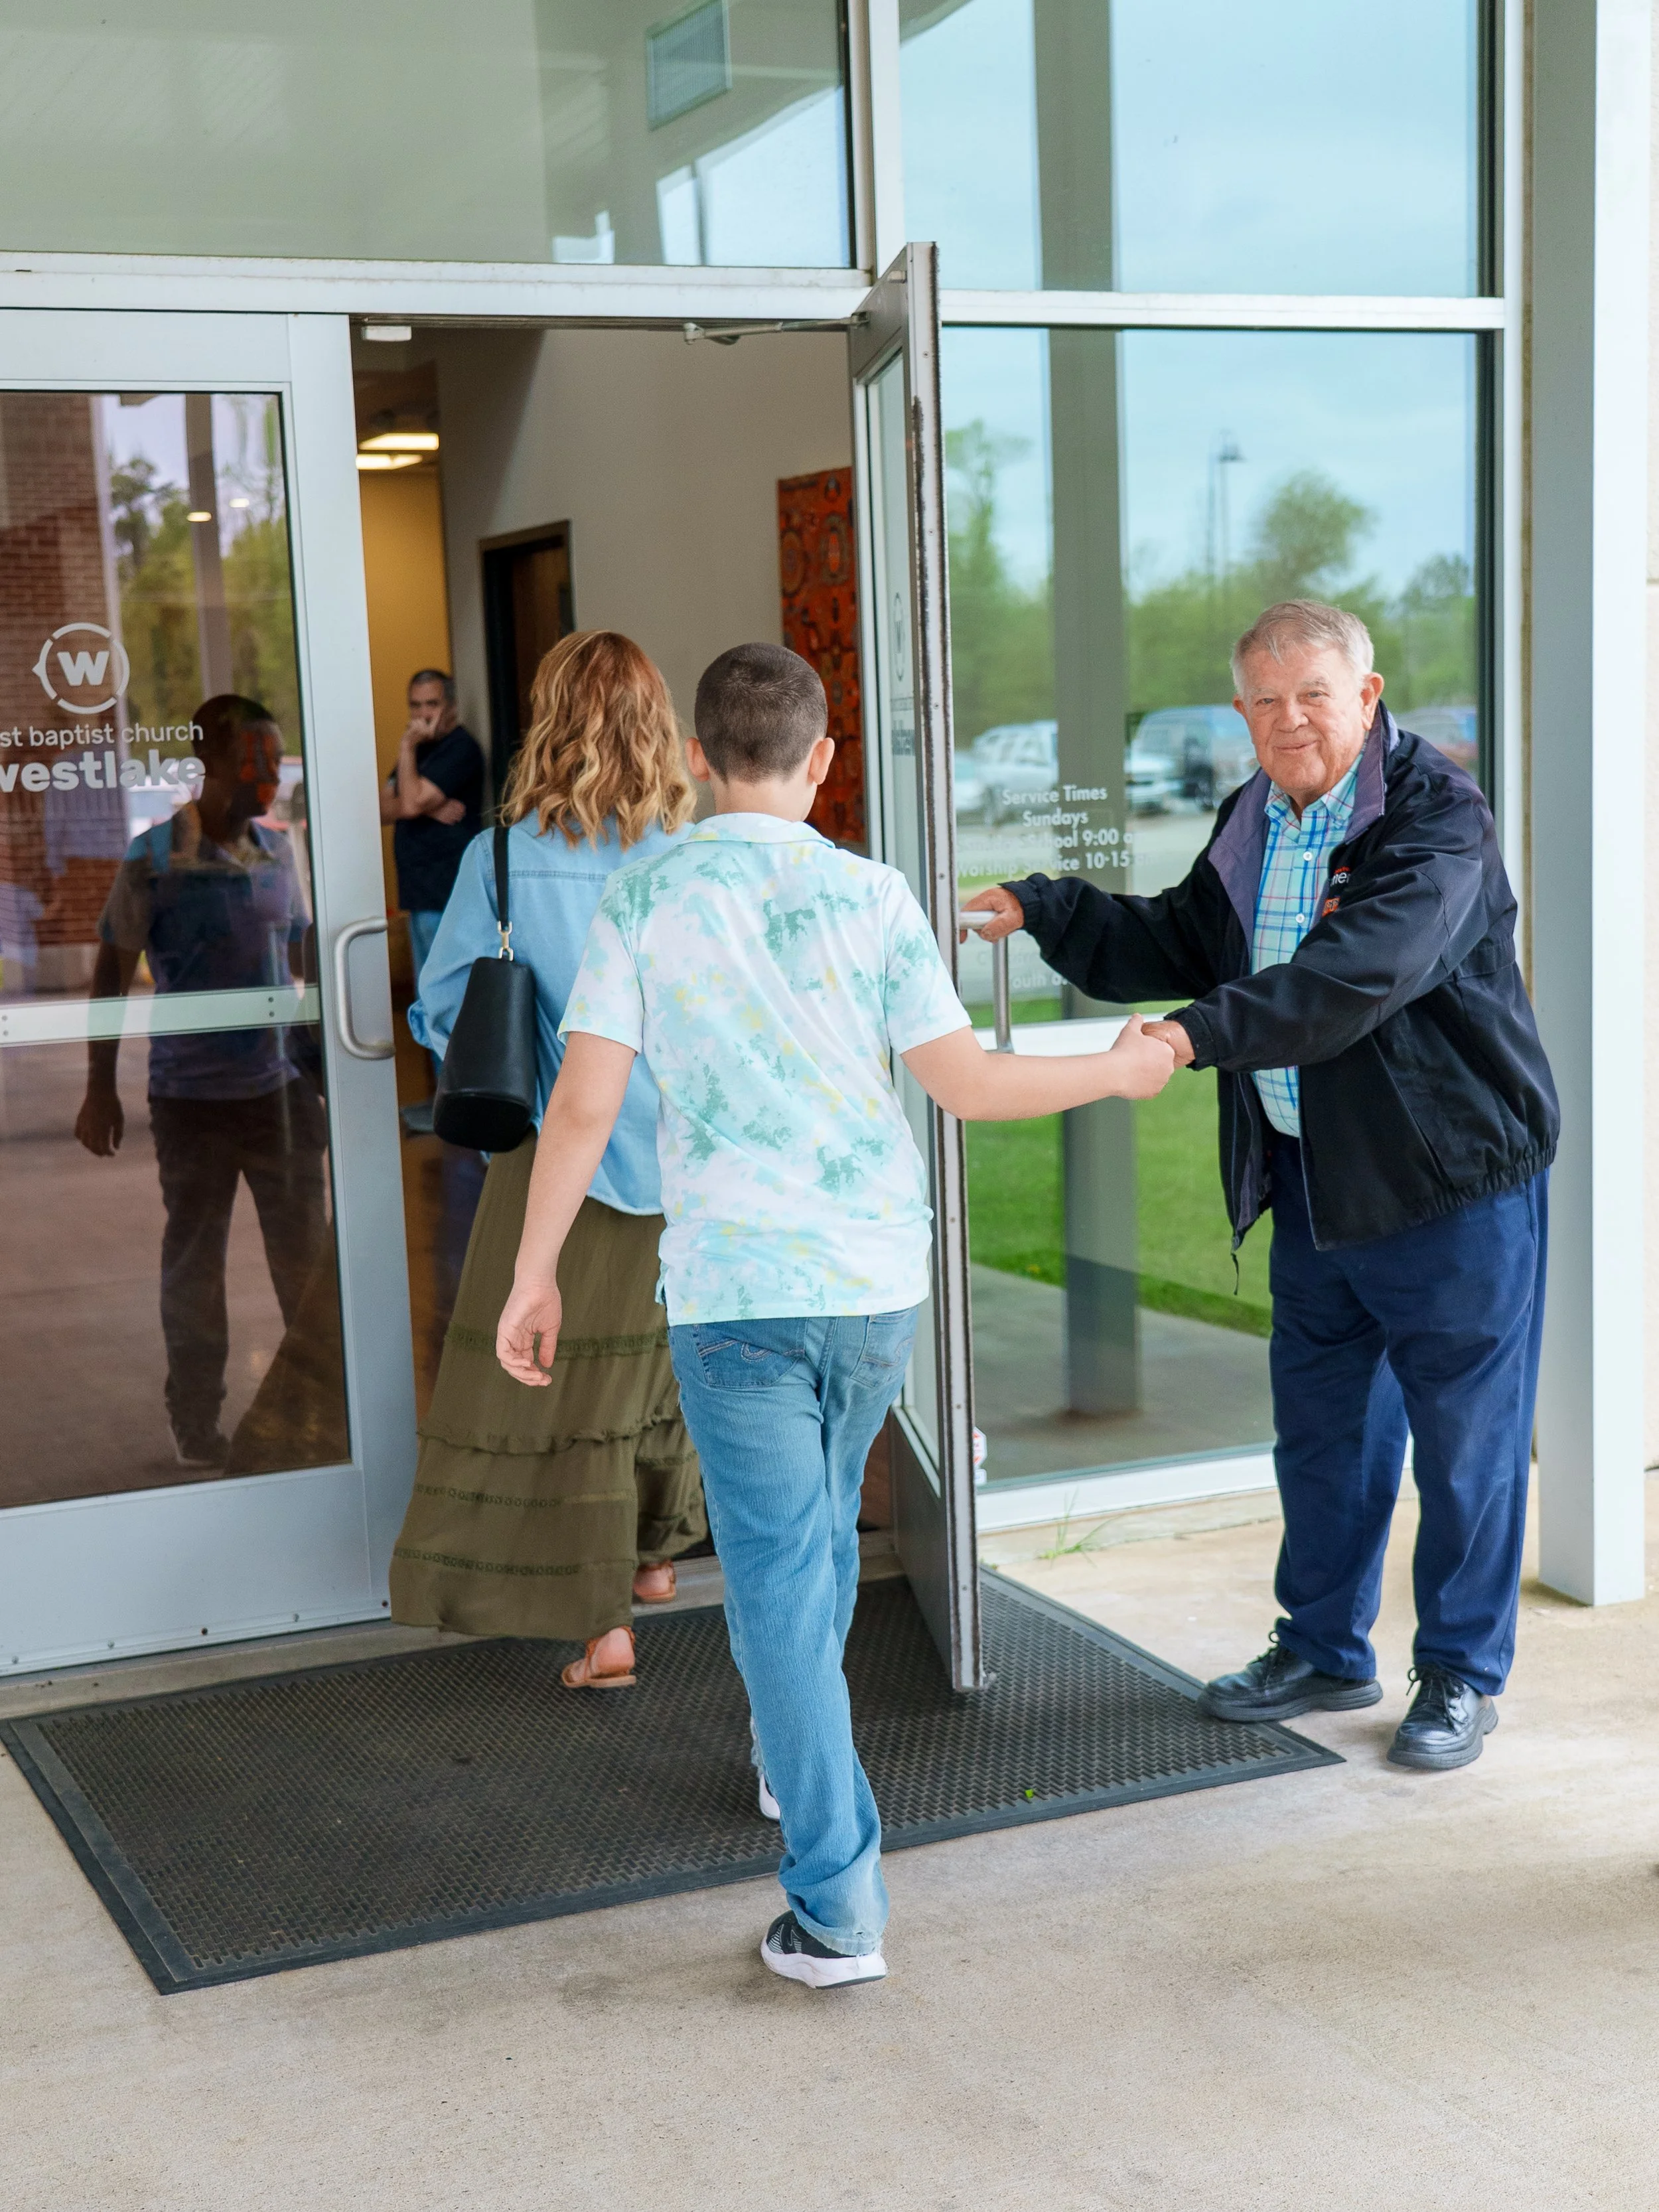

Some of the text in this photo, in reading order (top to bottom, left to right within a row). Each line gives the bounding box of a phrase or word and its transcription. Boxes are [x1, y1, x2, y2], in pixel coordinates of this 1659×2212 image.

[56, 651, 109, 686] W
[29, 724, 115, 750] baptist
[121, 721, 204, 743] church
[1002, 784, 1108, 806] Service Times
[1023, 807, 1089, 830] Sundays
[1082, 828, 1119, 847] 9:00
